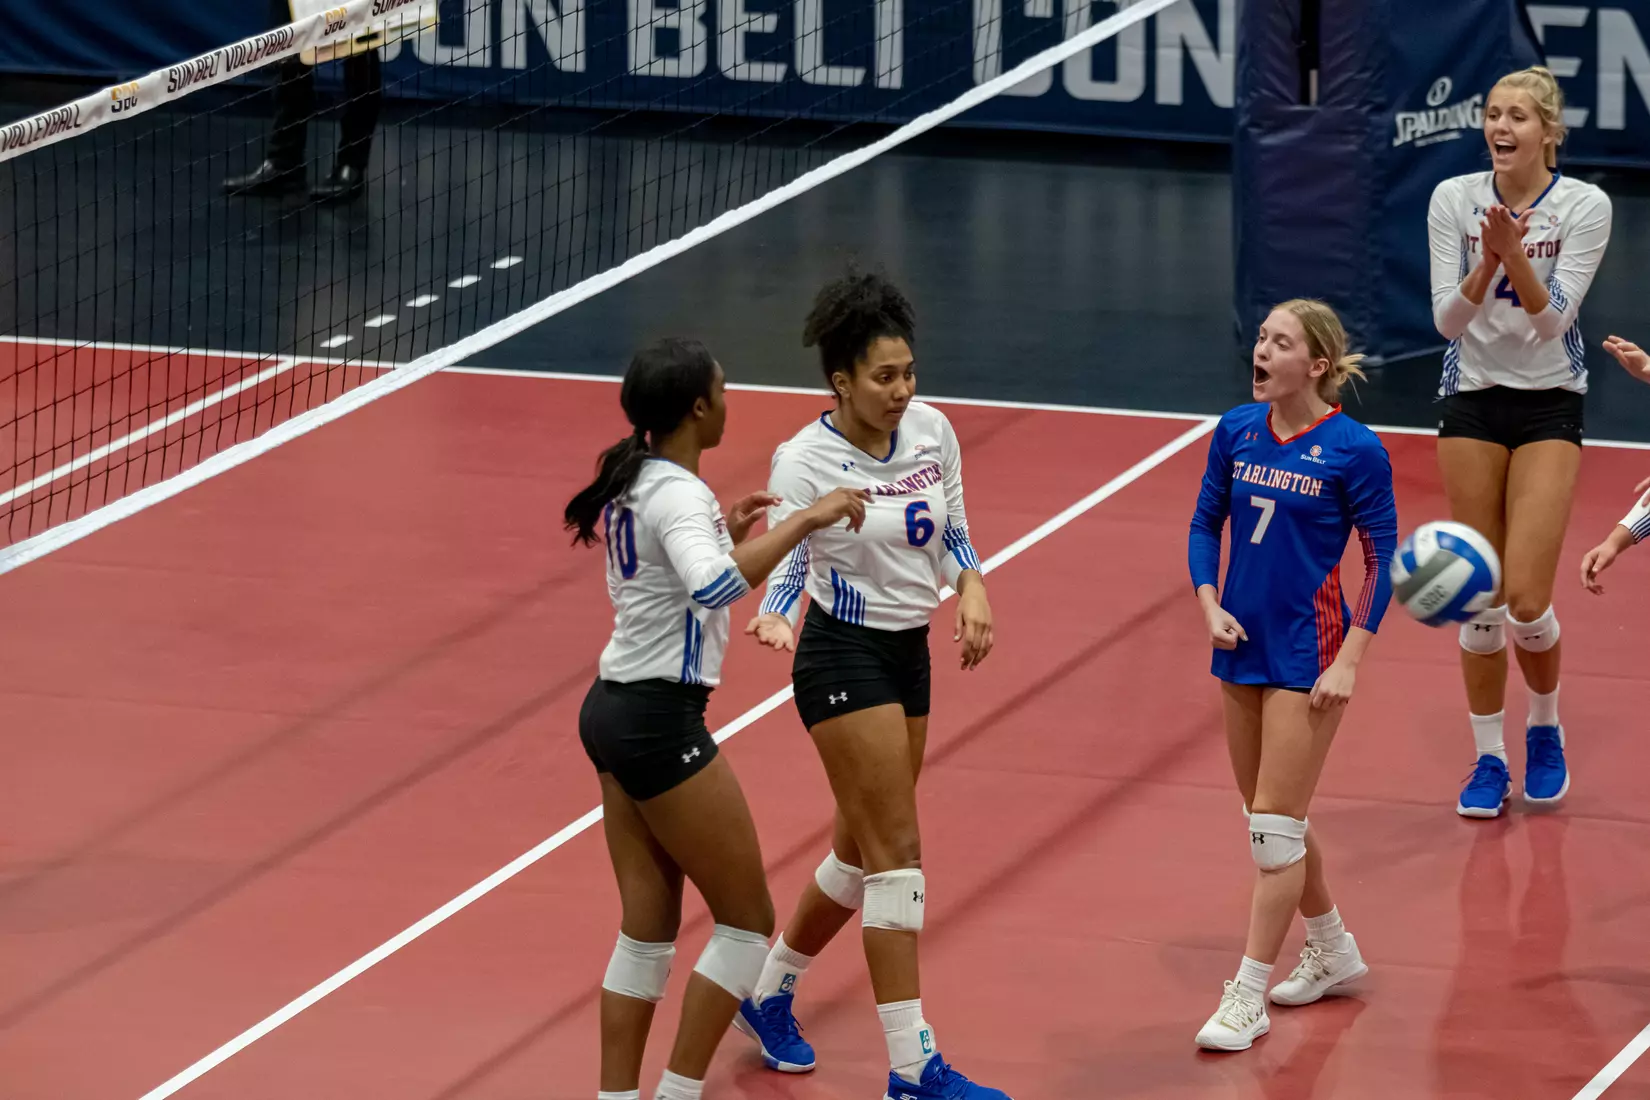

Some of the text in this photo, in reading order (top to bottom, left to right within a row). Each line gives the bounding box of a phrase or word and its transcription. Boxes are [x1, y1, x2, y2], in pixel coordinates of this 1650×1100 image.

[167, 26, 294, 93] SUN BELT VOLLEYBALL
[1, 103, 82, 152] VOLLEYBALL
[1393, 93, 1484, 147] SPALDING
[1241, 463, 1323, 497] ARLINGTON
[604, 500, 639, 581] 10
[904, 499, 935, 548] 6
[1250, 495, 1276, 545] 7
